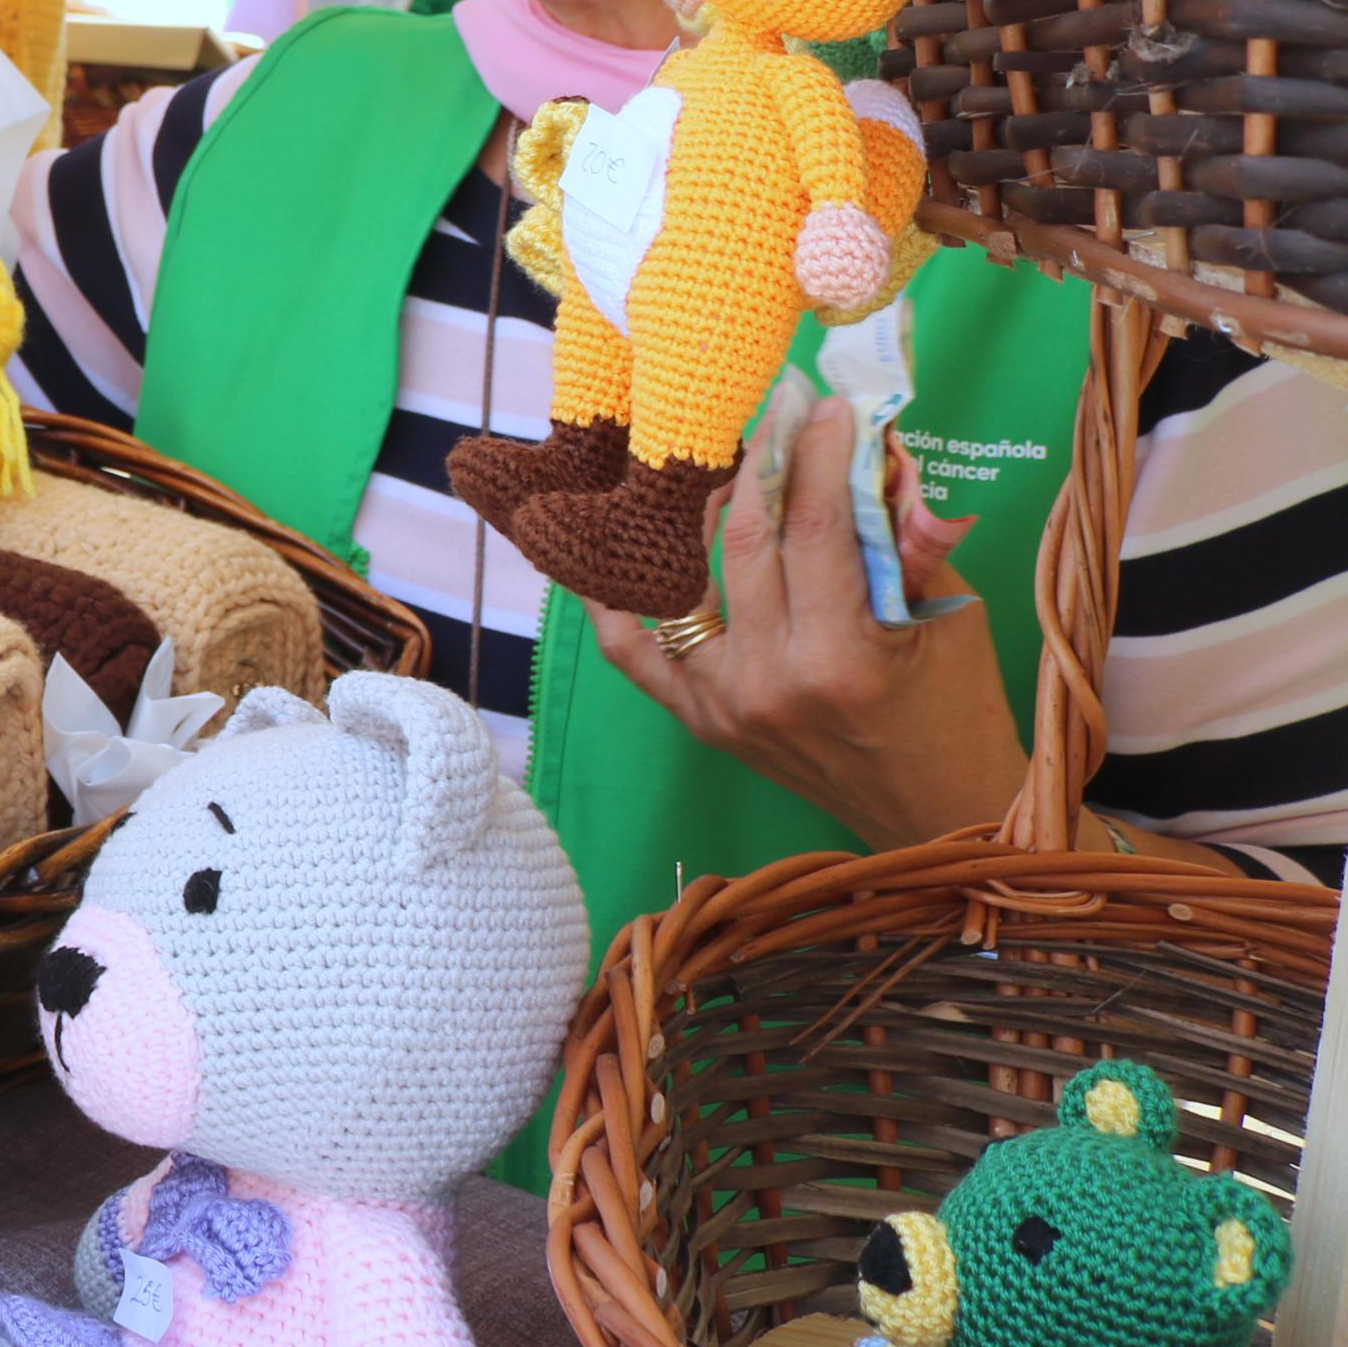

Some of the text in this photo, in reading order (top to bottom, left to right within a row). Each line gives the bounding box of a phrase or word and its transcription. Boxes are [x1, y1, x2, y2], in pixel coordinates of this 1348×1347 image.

[581, 141, 626, 185] 20€
[946, 439, 1047, 460] española
[926, 459, 1001, 481] cáncer
[129, 1275, 162, 1313] 25€
